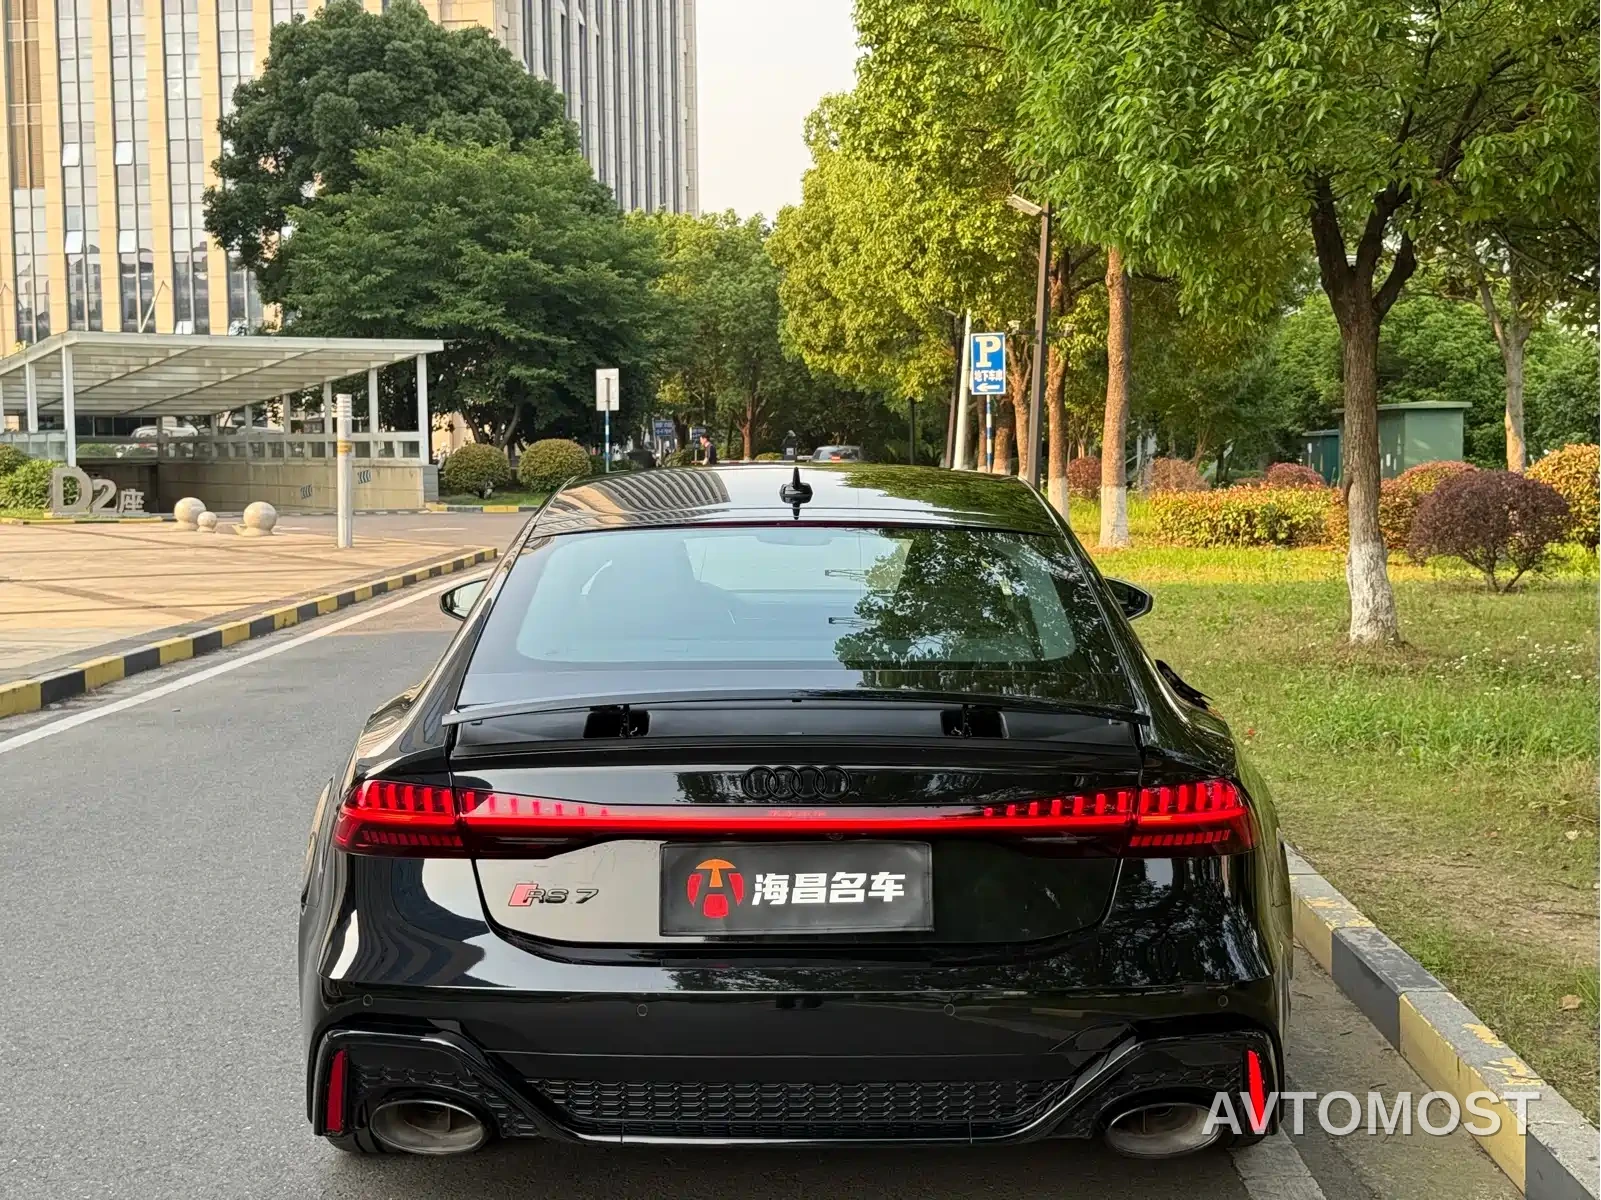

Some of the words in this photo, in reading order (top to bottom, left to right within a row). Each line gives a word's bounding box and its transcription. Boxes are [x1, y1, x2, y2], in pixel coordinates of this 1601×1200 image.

[975, 336, 1001, 368] P
[516, 886, 569, 904] RS
[575, 888, 599, 904] 7
[752, 871, 906, 905] 海昌名车
